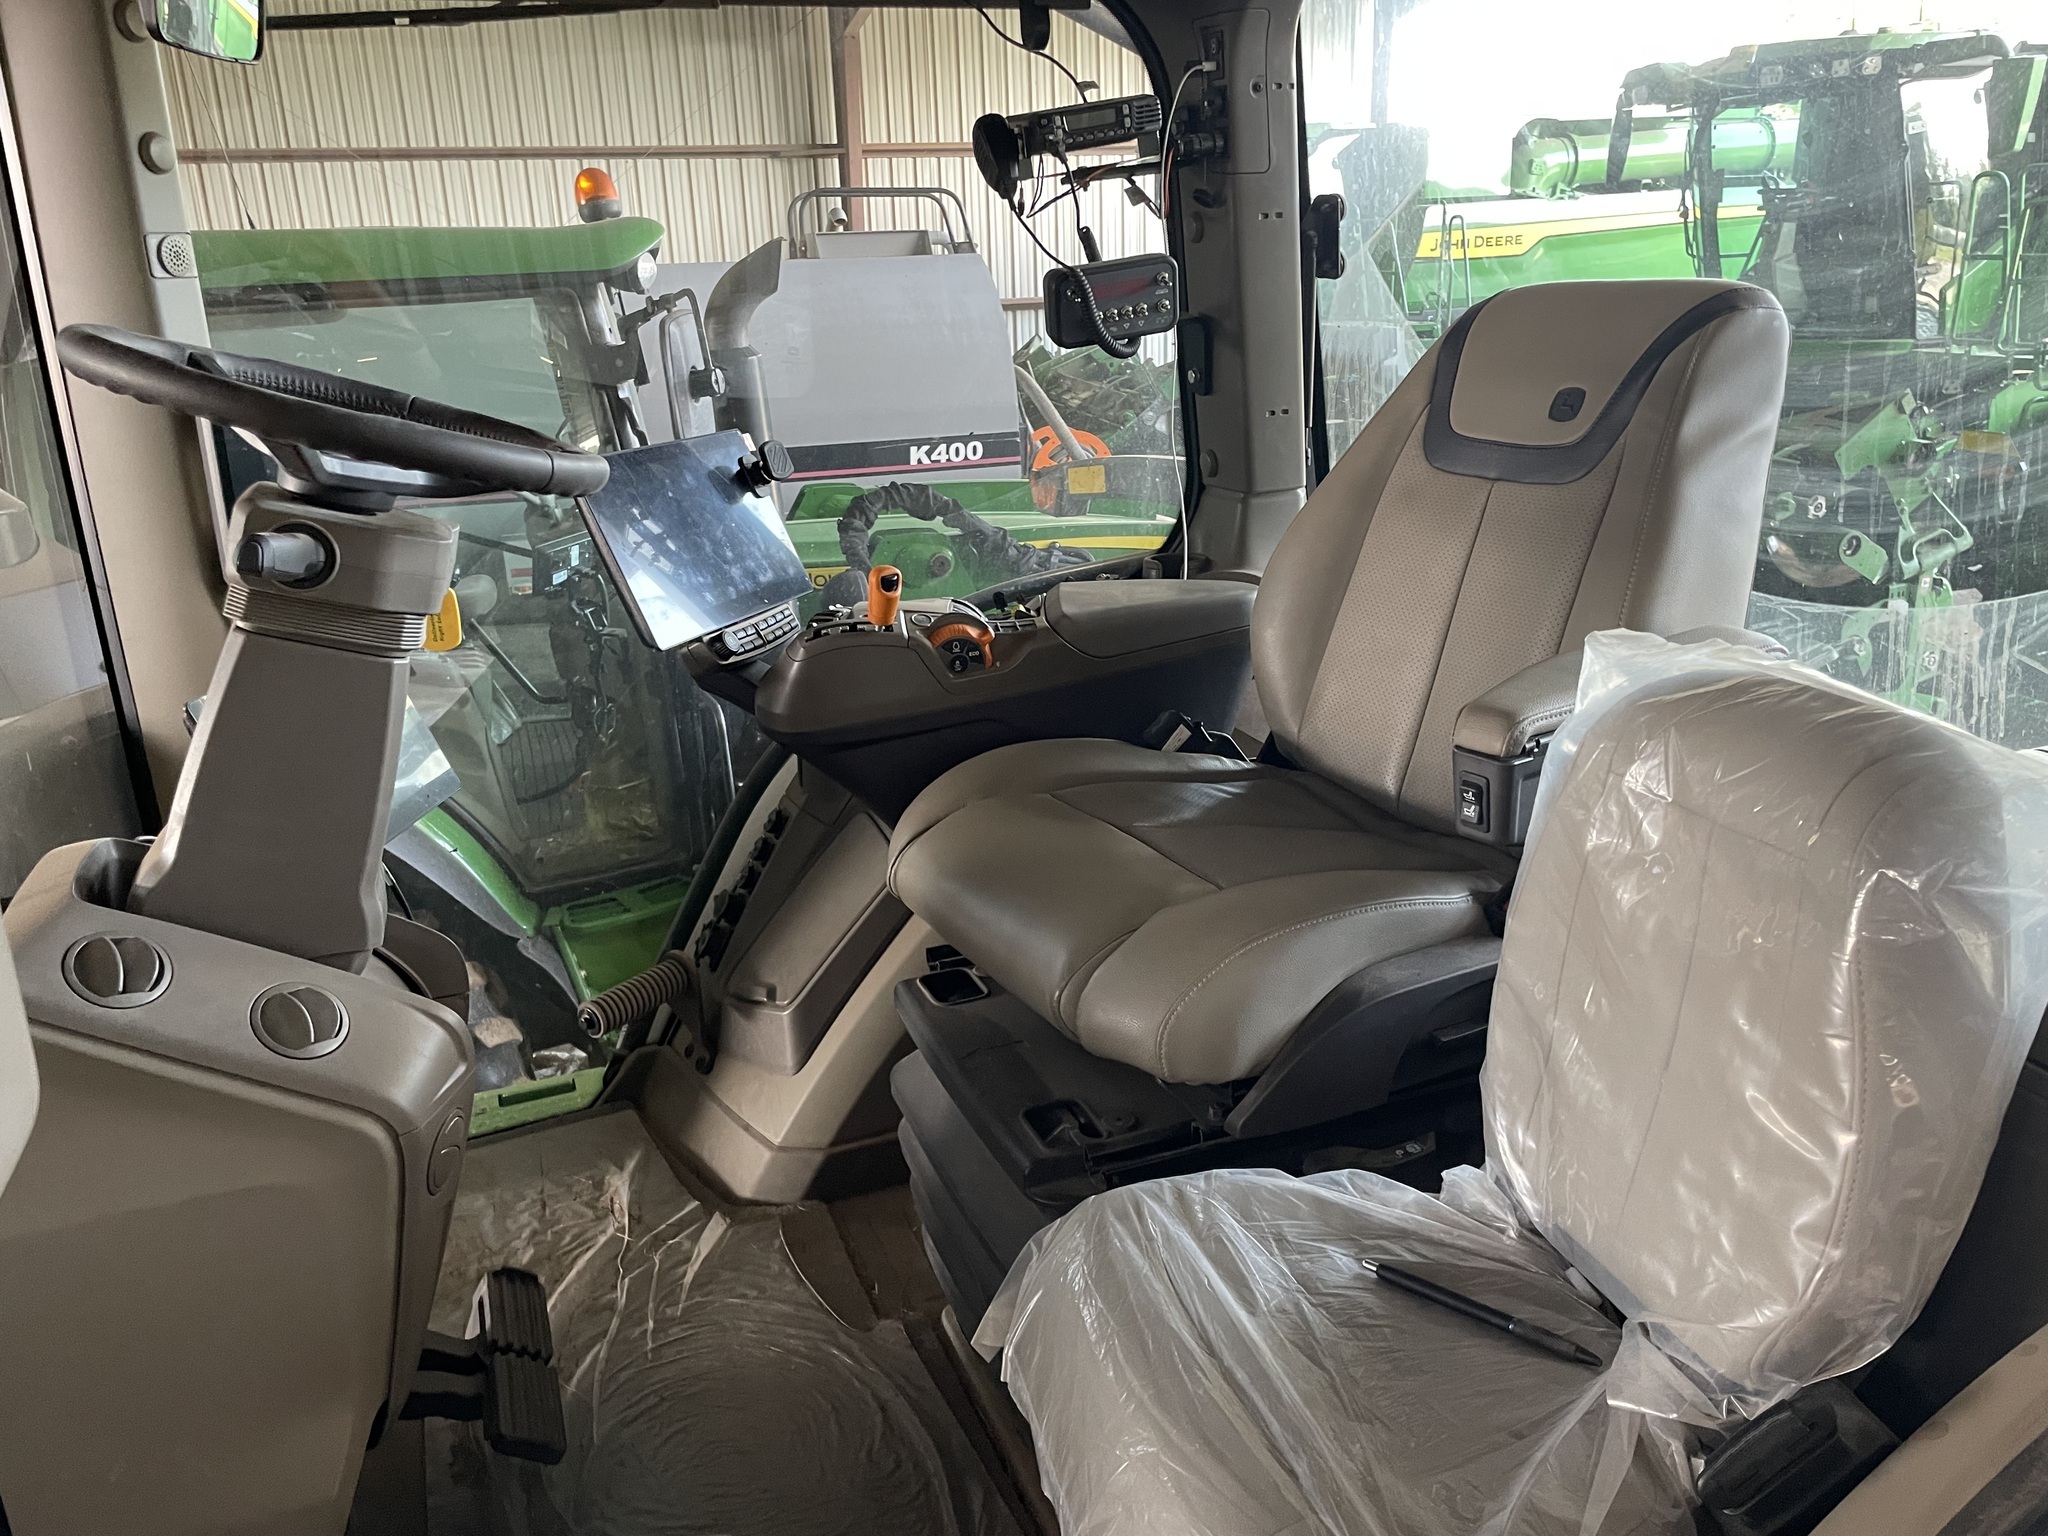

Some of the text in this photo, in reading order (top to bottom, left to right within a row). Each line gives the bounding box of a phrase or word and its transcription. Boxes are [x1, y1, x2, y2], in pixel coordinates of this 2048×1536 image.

[1430, 234, 1524, 252] JHN DEERE
[909, 440, 984, 466] K400
